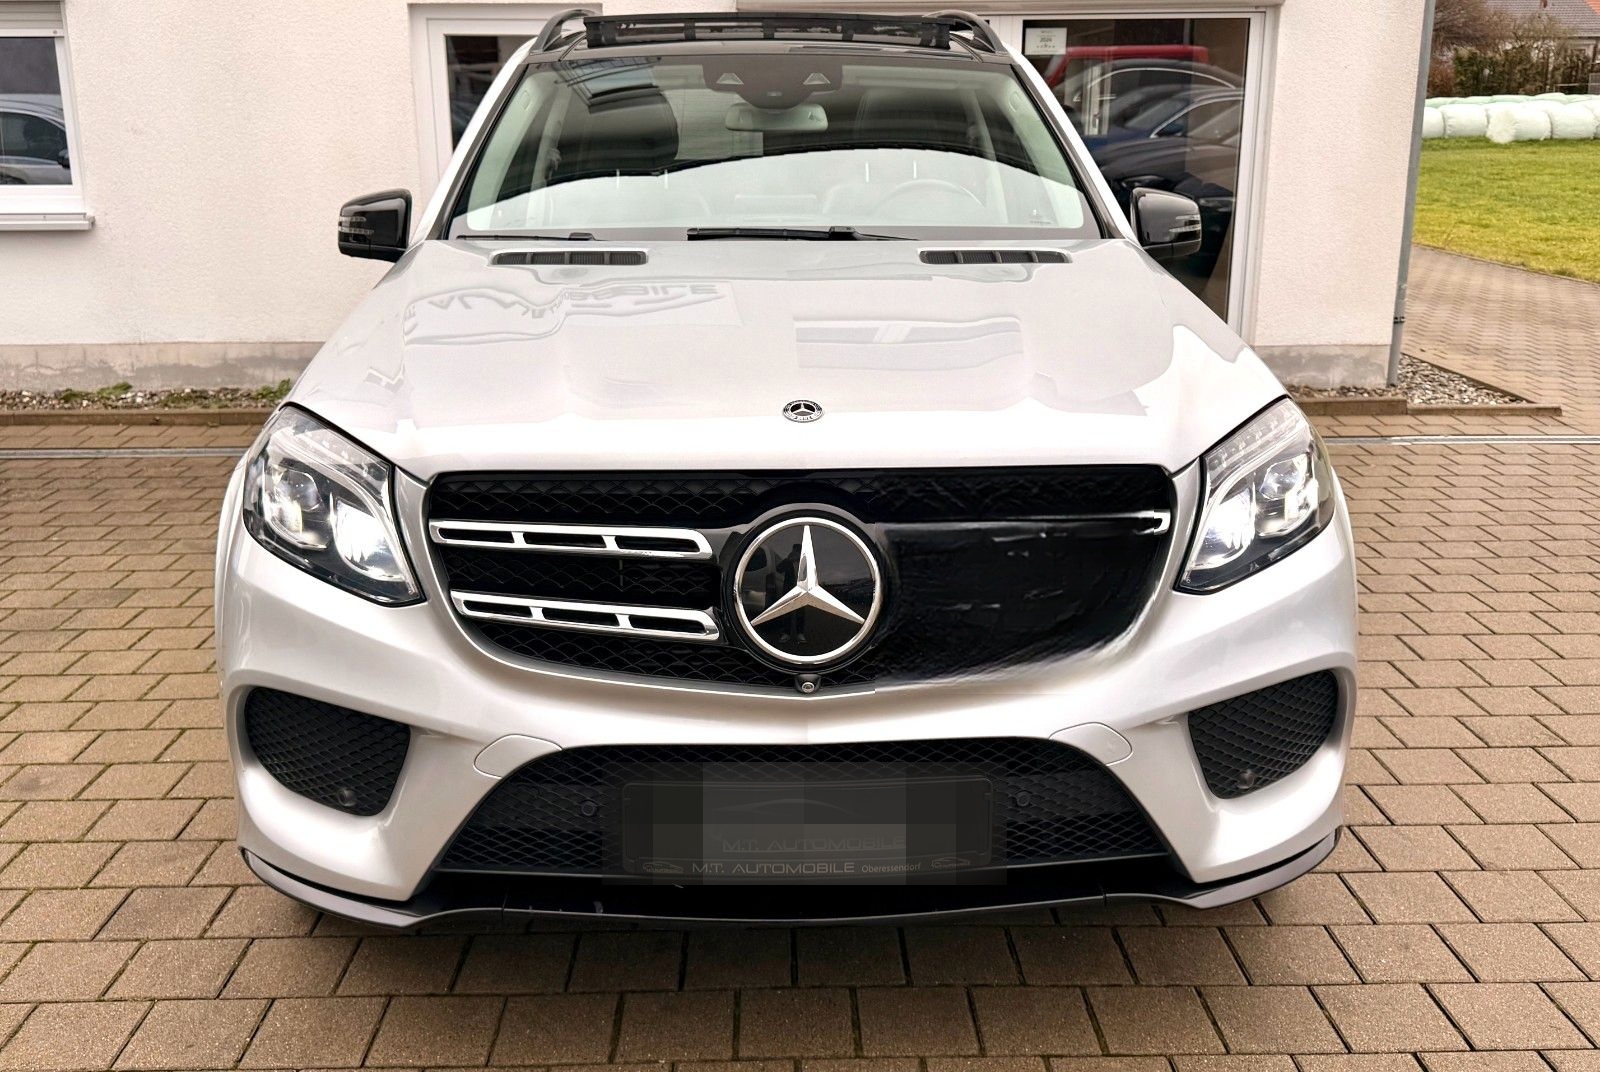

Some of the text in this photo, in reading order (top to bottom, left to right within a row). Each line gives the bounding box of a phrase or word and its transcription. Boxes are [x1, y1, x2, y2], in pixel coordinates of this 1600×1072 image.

[722, 836, 906, 851] M.T. AUTOMOBILE
[692, 863, 725, 873] M.T.
[731, 862, 855, 874] AUTOMOBILE
[861, 861, 922, 873] Oberessendorf
